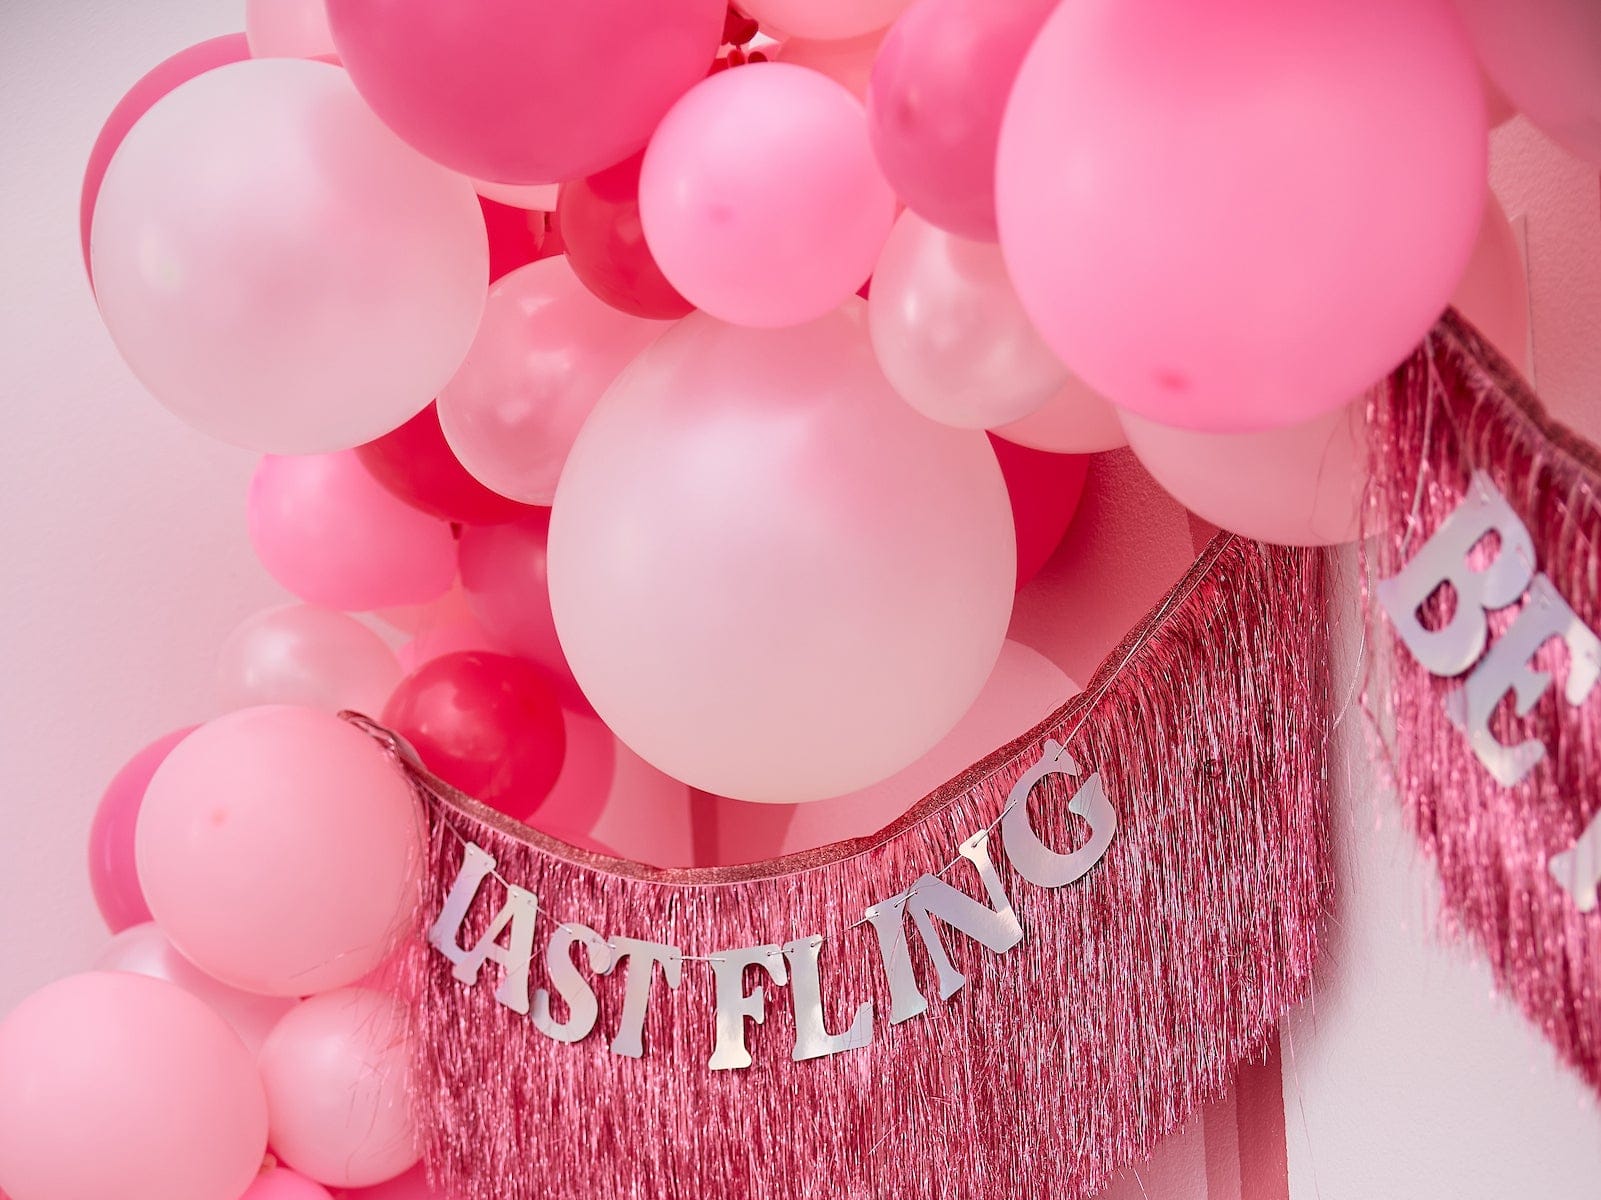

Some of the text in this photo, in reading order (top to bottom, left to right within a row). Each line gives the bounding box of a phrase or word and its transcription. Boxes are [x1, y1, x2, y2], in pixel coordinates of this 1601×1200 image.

[1378, 468, 1601, 912] BE
[428, 740, 1117, 1071] LAST FLING
